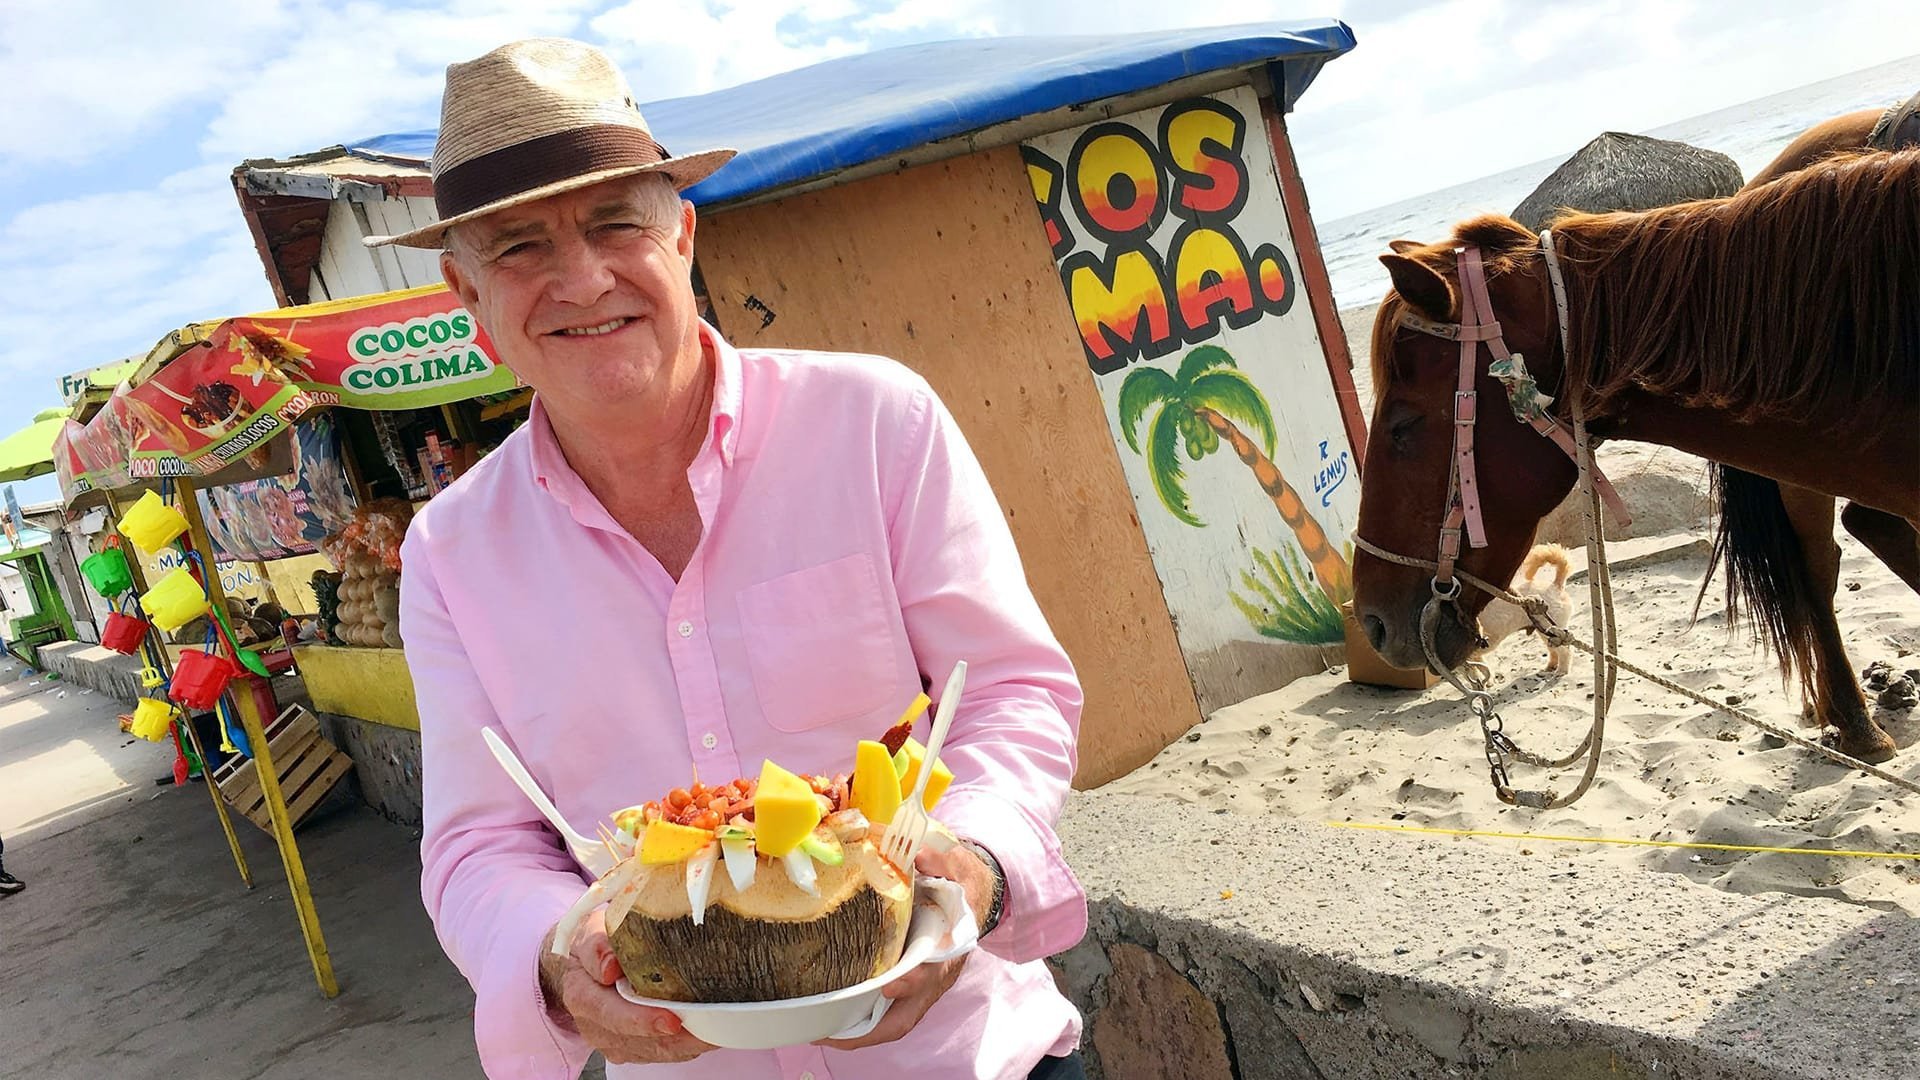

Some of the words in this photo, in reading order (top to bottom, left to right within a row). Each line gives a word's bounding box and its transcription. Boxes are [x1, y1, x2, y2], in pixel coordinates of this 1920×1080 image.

[355, 315, 471, 356] COCOS
[348, 350, 488, 389] COLIMA
[214, 434, 252, 461] CHURROS
[243, 414, 279, 442] LOCOS
[1318, 440, 1329, 461] R
[1313, 451, 1348, 507] LEMUS
